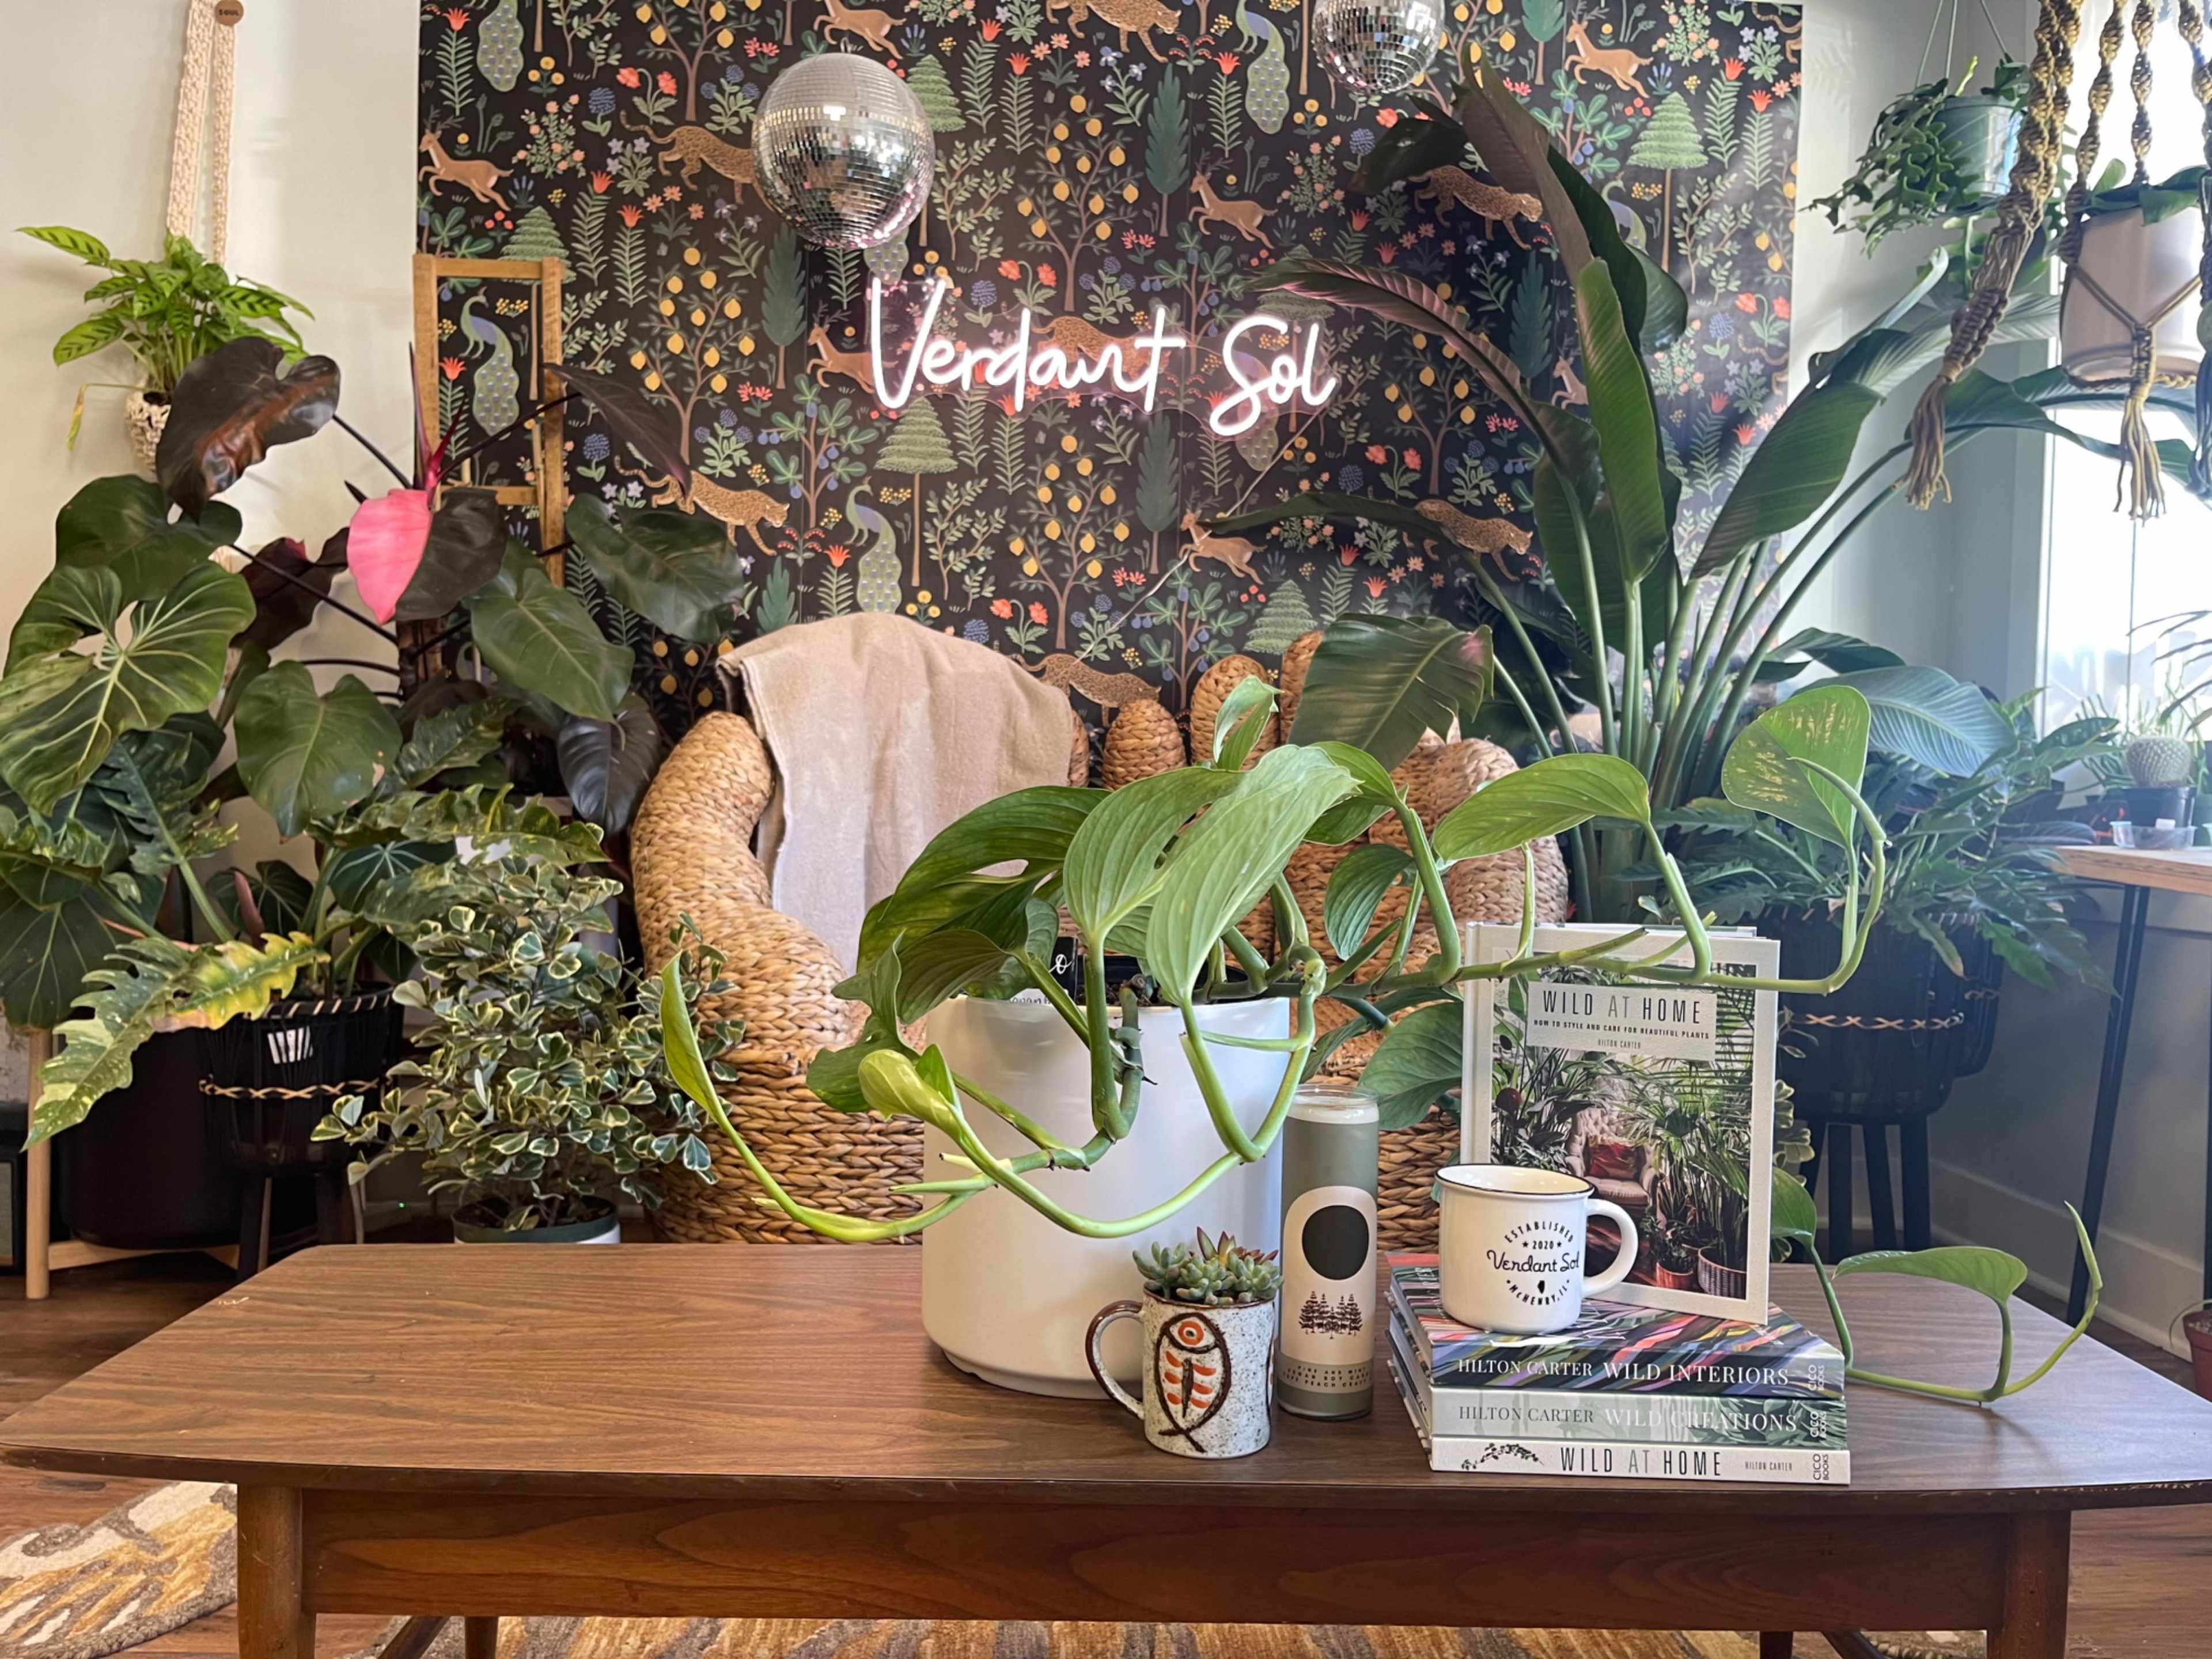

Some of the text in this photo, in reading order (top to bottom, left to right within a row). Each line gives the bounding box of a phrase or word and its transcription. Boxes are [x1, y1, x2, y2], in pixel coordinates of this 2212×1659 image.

[870, 277, 1338, 437] Verdant Sol
[1543, 990, 1700, 1024] WILD AT HOME
[1563, 1021, 1584, 1029] STYLE
[1640, 1028, 1679, 1037] BEAUTIFUL
[1681, 1031, 1710, 1039] PLANTS
[1597, 1039, 1641, 1049] HILTON CARTER
[1504, 1221, 1574, 1243] ESTABLISHED
[1532, 1240, 1554, 1250] 2020
[1486, 1249, 1581, 1272] Verdant Sol
[1458, 1358, 1789, 1386] HILTON CARTER WILD INTERIORS
[1808, 1364, 1817, 1391] CICO
[1459, 1406, 1797, 1432] HILTON CARTER WILD CREATIONS
[1810, 1411, 1819, 1437] CICO
[1560, 1446, 1793, 1476] WILD AT HOME HILTON CARTER
[1813, 1453, 1821, 1480] CICO
